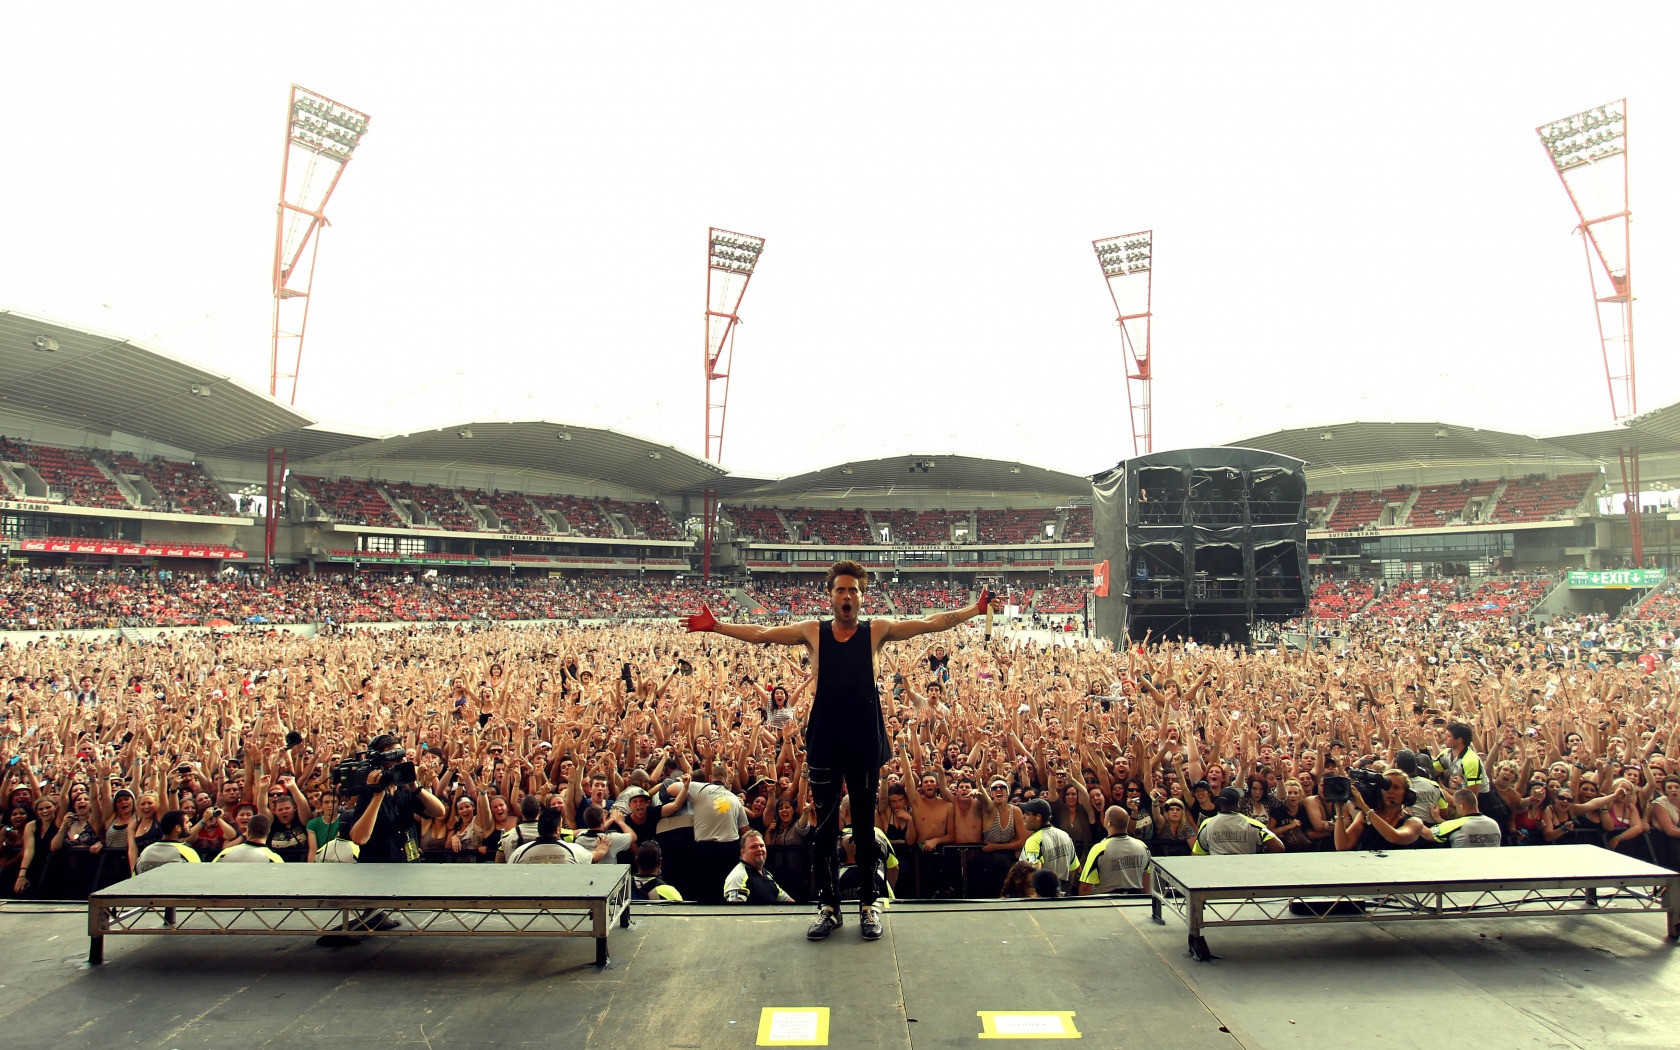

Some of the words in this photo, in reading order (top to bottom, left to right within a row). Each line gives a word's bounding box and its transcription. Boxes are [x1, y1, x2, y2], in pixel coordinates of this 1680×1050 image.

[16, 503, 50, 511] STAND
[1601, 572, 1631, 584] EXIT
[1213, 830, 1248, 841] SECURITY
[1112, 854, 1144, 867] SECURITY
